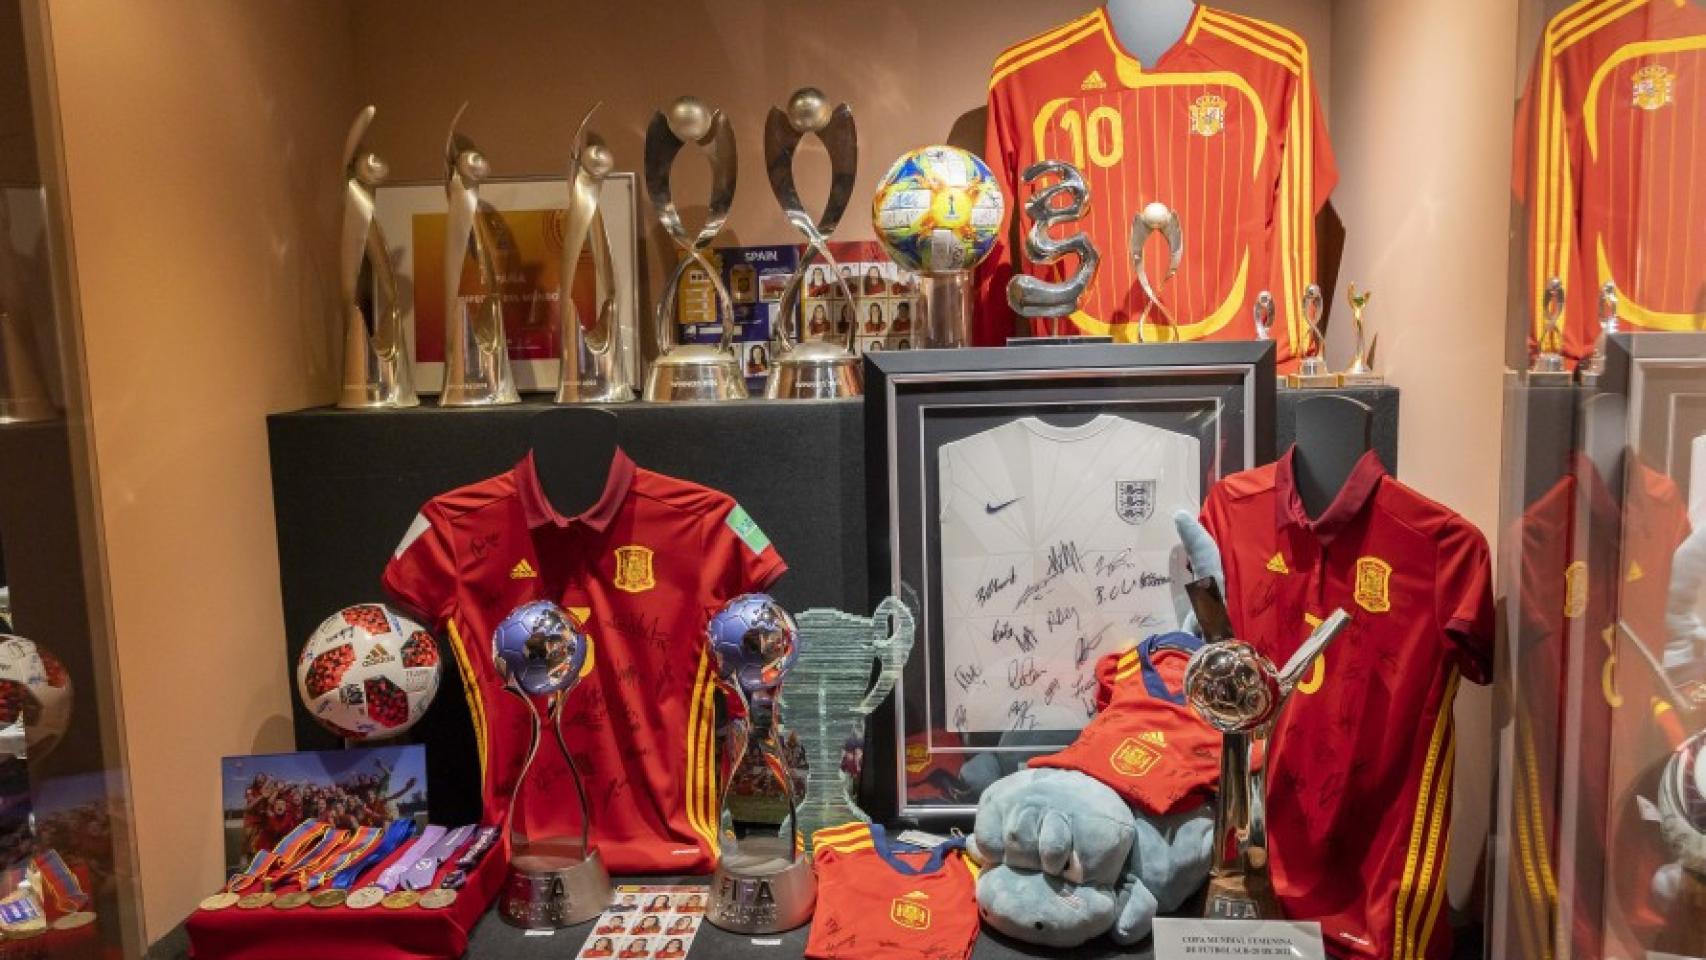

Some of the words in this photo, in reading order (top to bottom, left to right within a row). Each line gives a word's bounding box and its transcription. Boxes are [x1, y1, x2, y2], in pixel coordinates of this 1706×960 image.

[1060, 106, 1123, 170] 10
[744, 250, 778, 261] SPAIN
[721, 876, 776, 905] FIFA
